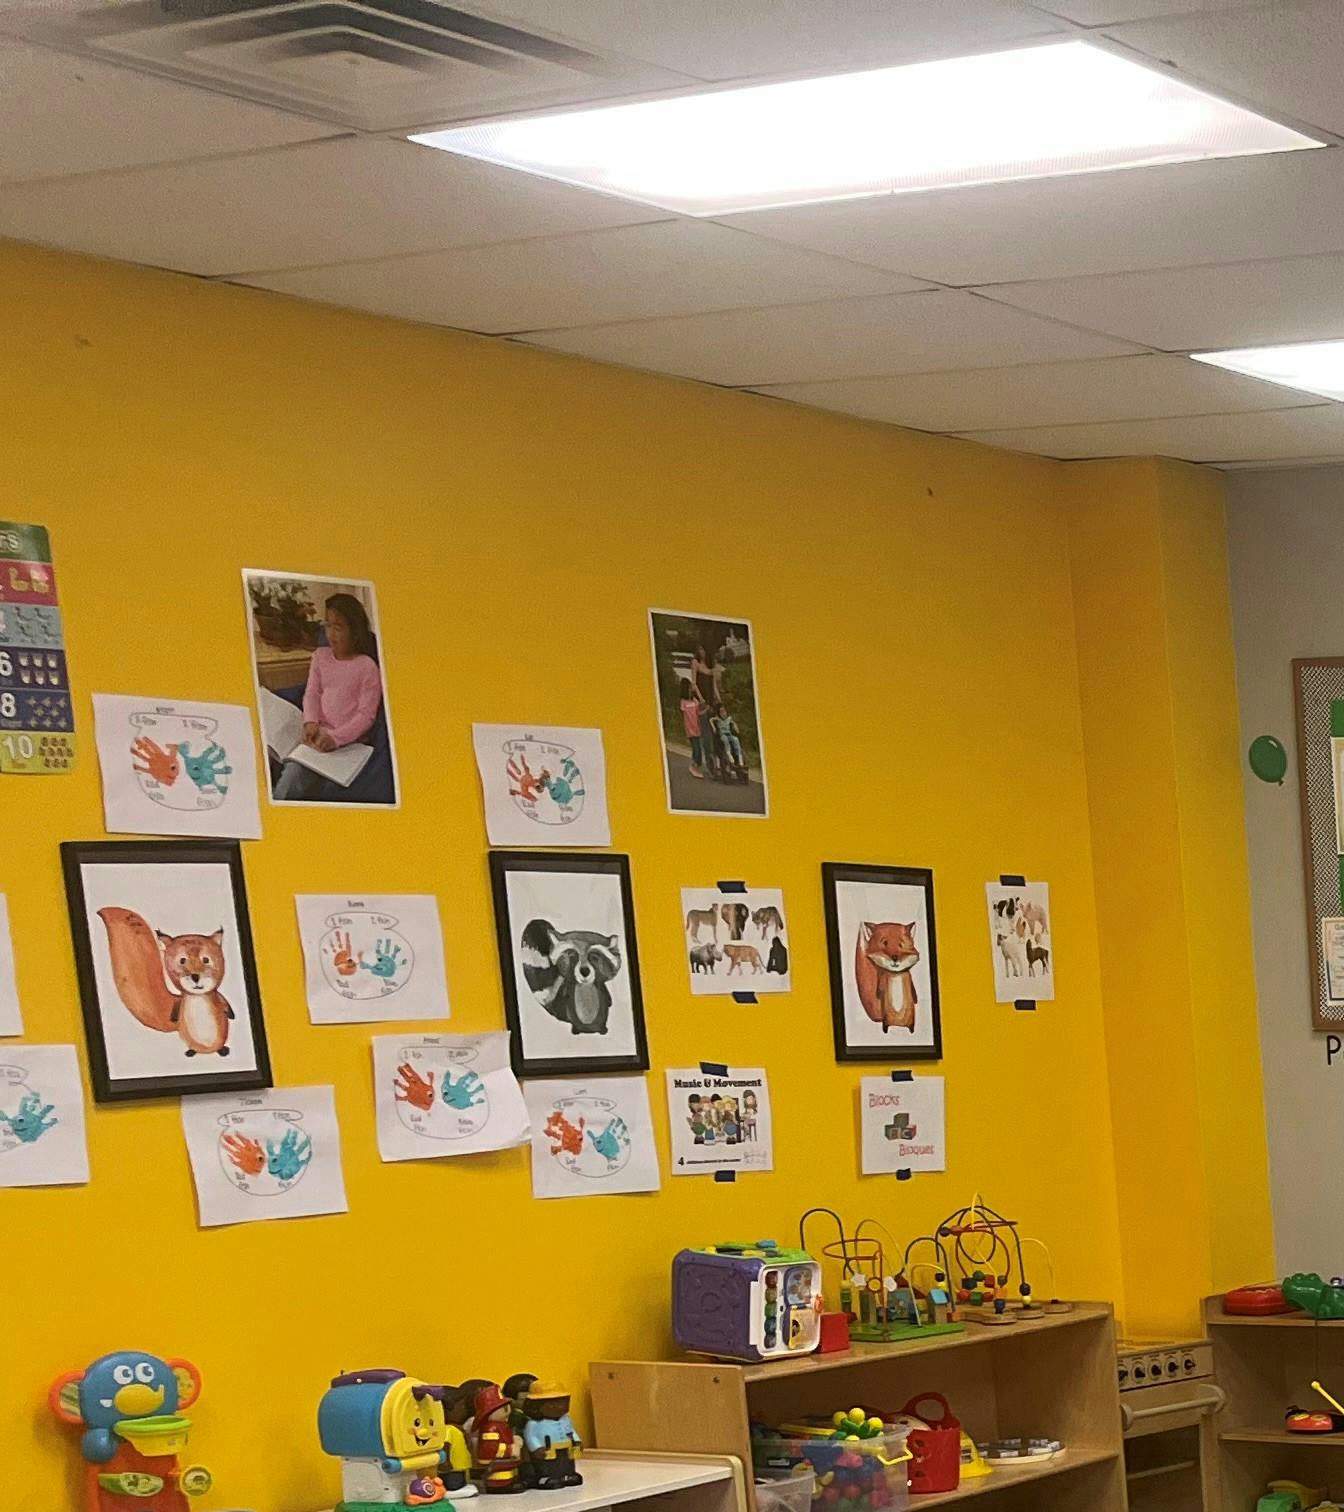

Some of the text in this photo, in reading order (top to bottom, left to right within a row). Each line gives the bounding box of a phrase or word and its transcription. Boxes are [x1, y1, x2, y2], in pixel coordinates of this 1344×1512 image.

[0, 692, 17, 718] 8
[3, 735, 34, 760] 10
[674, 1079, 702, 1088] Music
[713, 1079, 762, 1087] Movement
[868, 1093, 900, 1108] Blocks
[678, 1157, 685, 1166] 4
